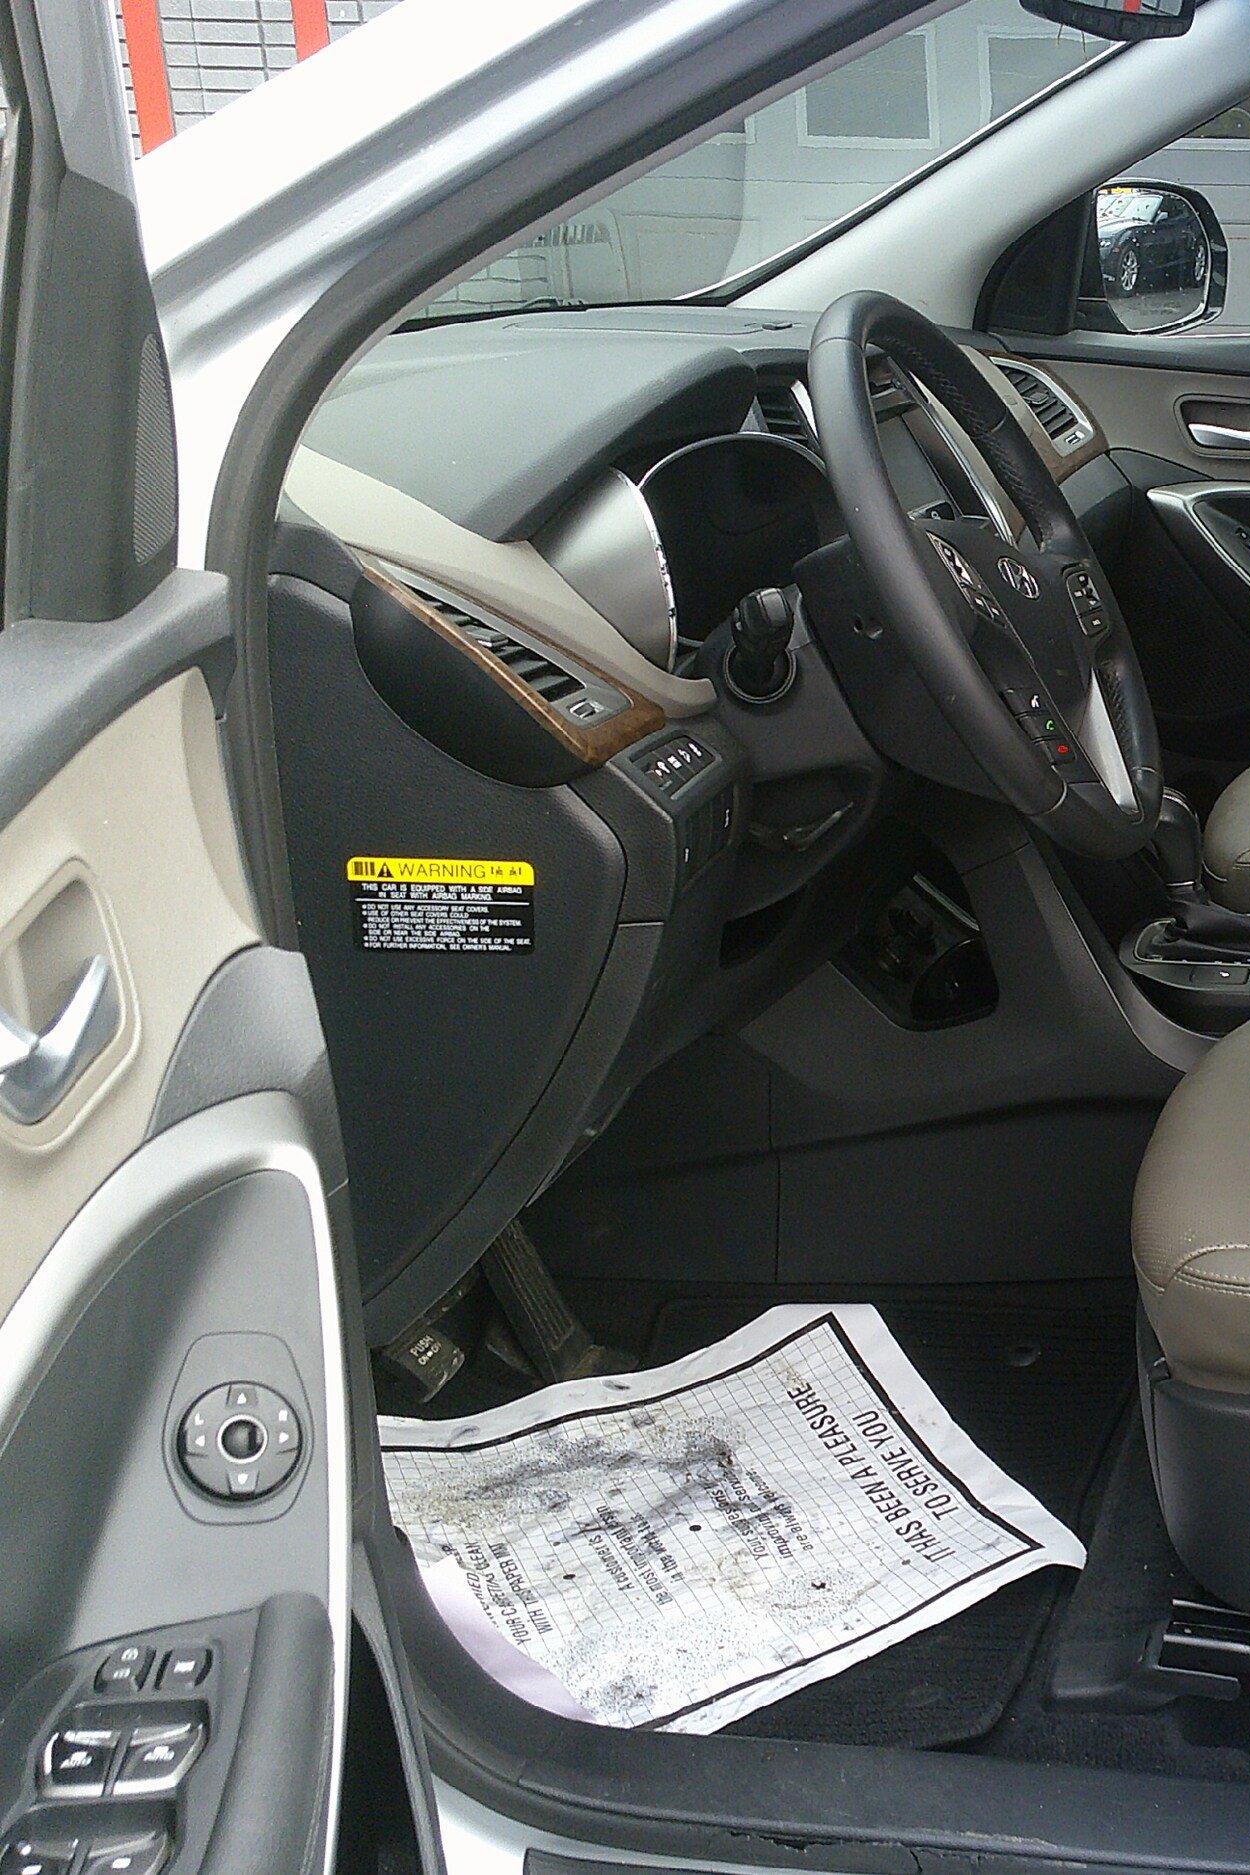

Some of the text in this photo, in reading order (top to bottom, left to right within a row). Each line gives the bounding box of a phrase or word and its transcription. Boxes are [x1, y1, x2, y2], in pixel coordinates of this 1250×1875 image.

[399, 863, 486, 879] WARNING
[410, 1335, 434, 1357] PUSH
[787, 1382, 956, 1563] IT HAS BEEN A PLEASURE
[852, 1410, 959, 1520] TO SERVE YOU
[711, 1488, 754, 1536] suggesons
[464, 1541, 490, 1571] CLEAN
[747, 1534, 769, 1560] Your
[796, 1533, 814, 1551] are
[500, 1558, 525, 1593] PAPER
[589, 1534, 635, 1591] A customer is
[659, 1552, 678, 1573] the
[638, 1566, 663, 1592] most
[506, 1616, 532, 1645] YOUR
[527, 1607, 553, 1634] WITH
